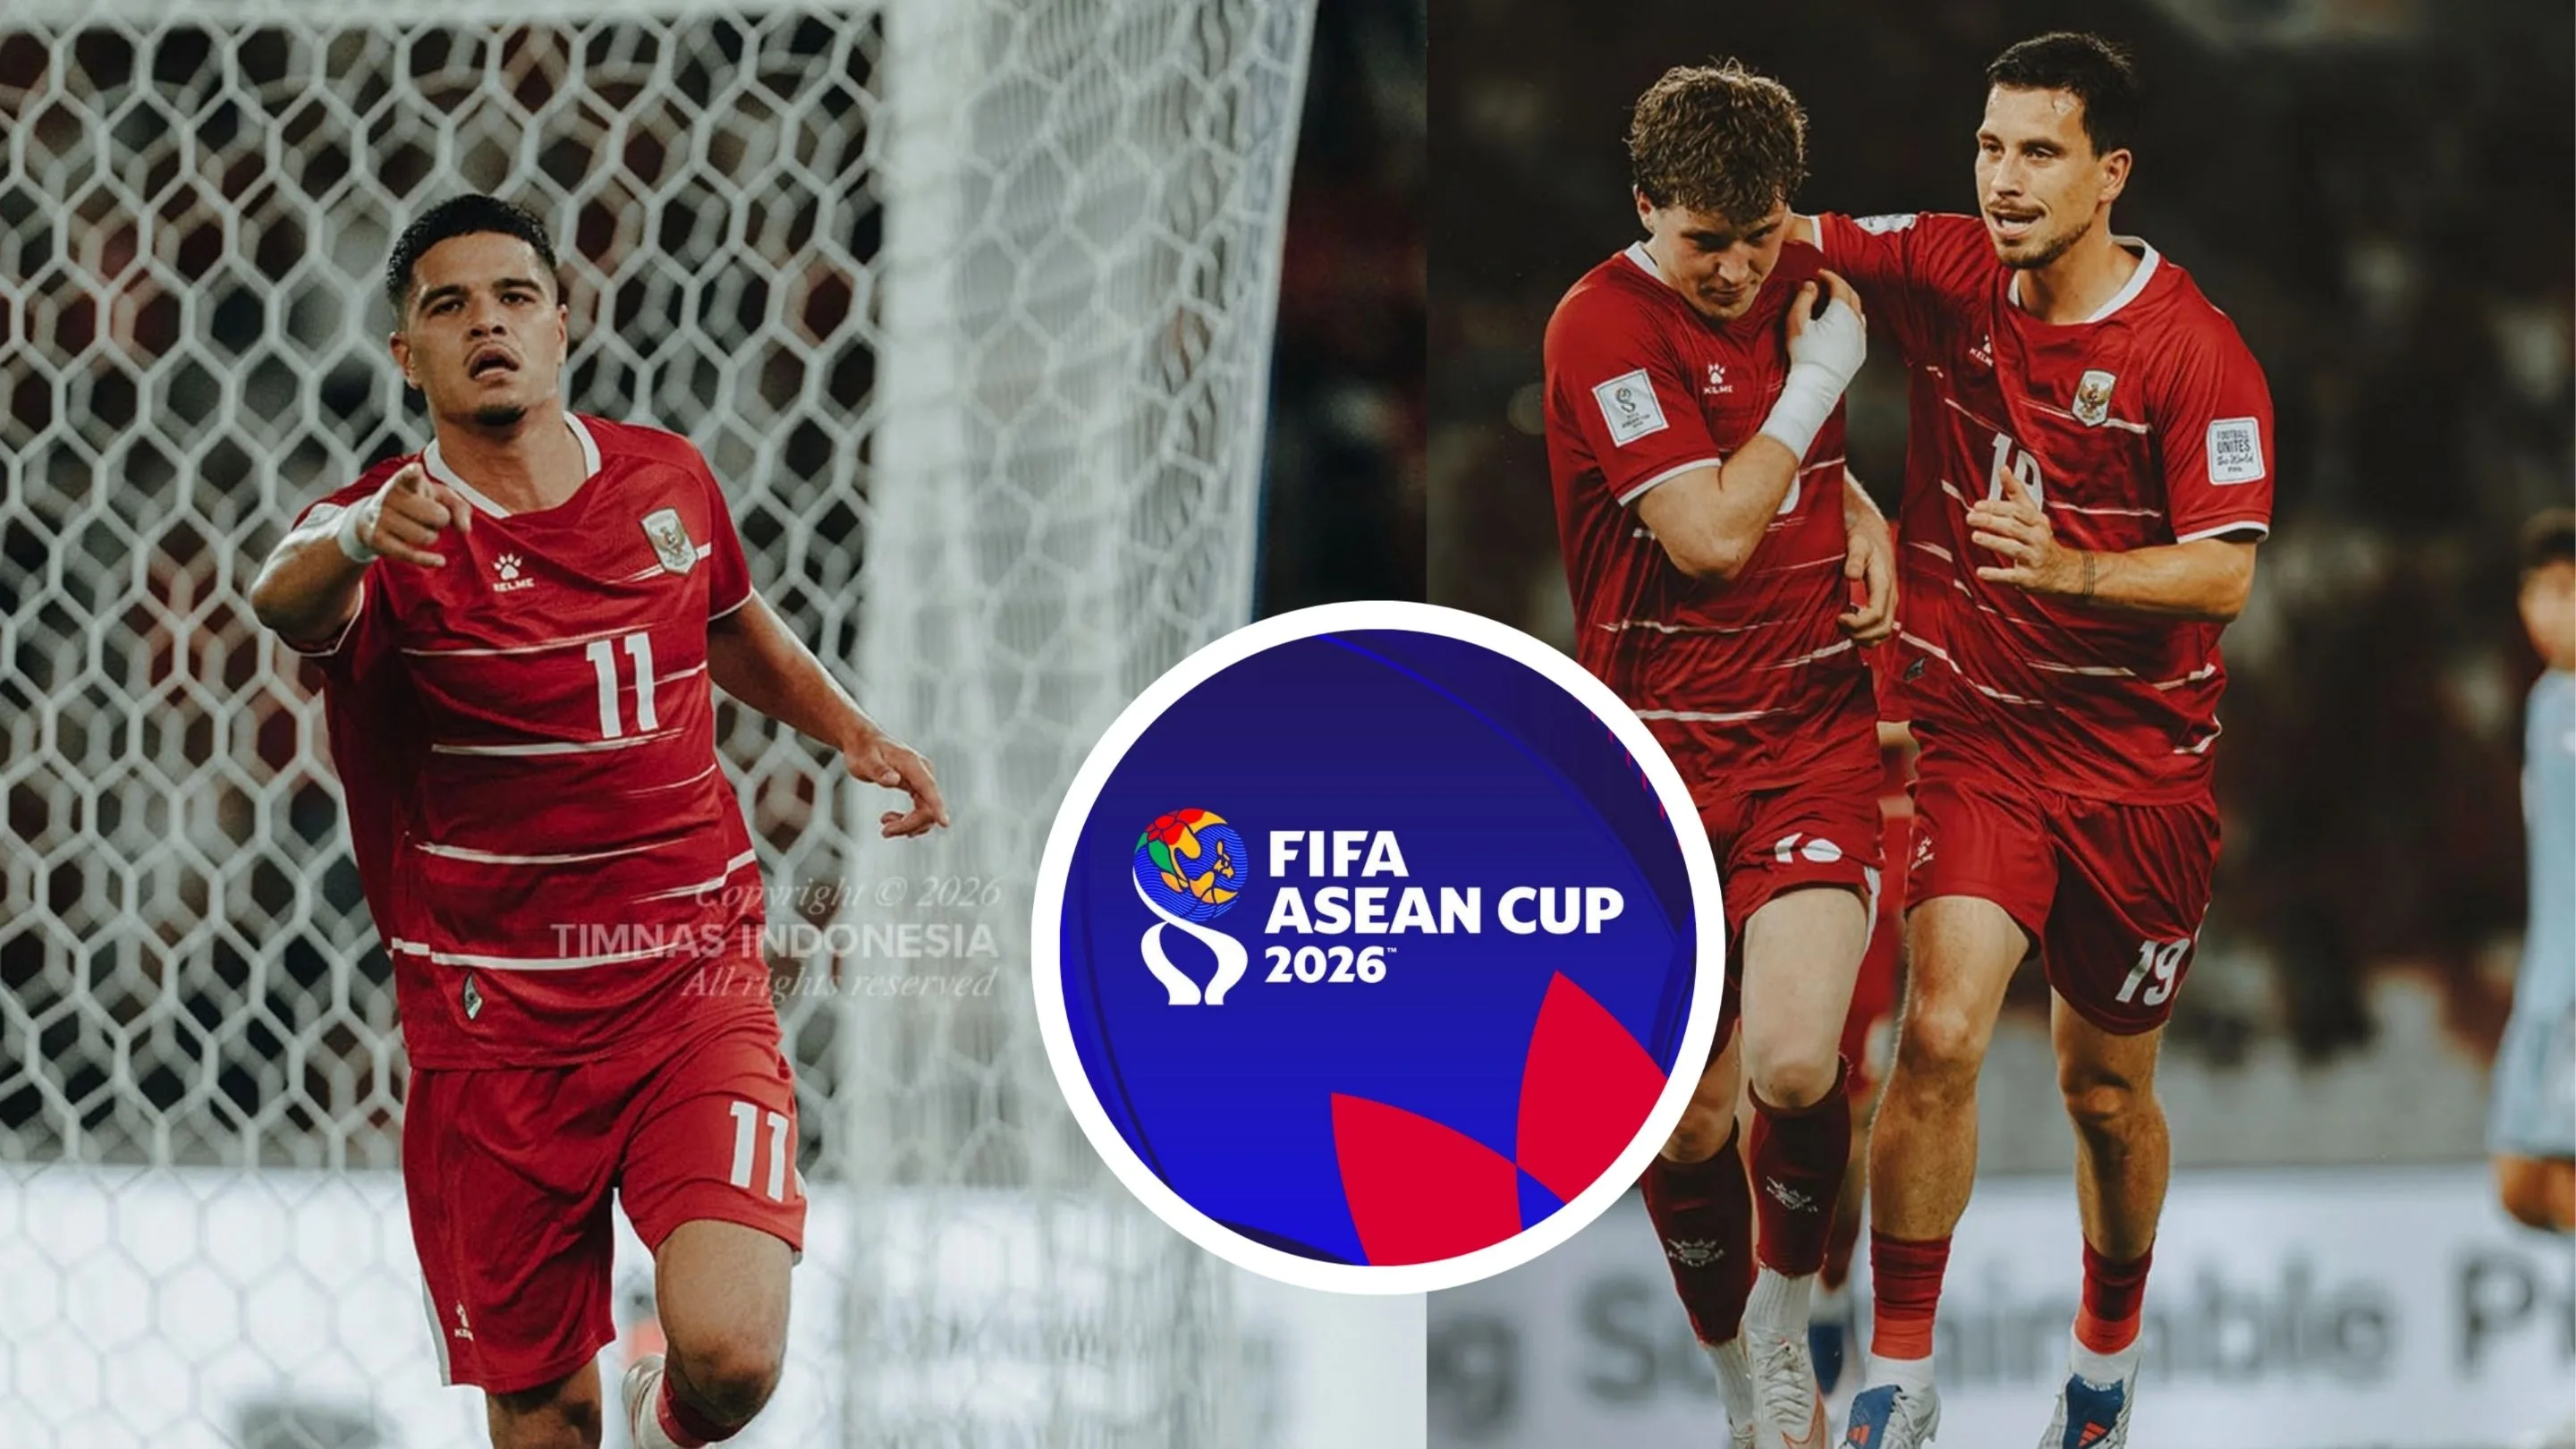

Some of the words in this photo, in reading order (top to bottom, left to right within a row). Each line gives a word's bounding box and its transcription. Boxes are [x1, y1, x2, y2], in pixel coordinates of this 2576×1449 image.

[586, 631, 659, 738] 11
[2114, 936, 2191, 1006] 19
[730, 1101, 789, 1202] 11
